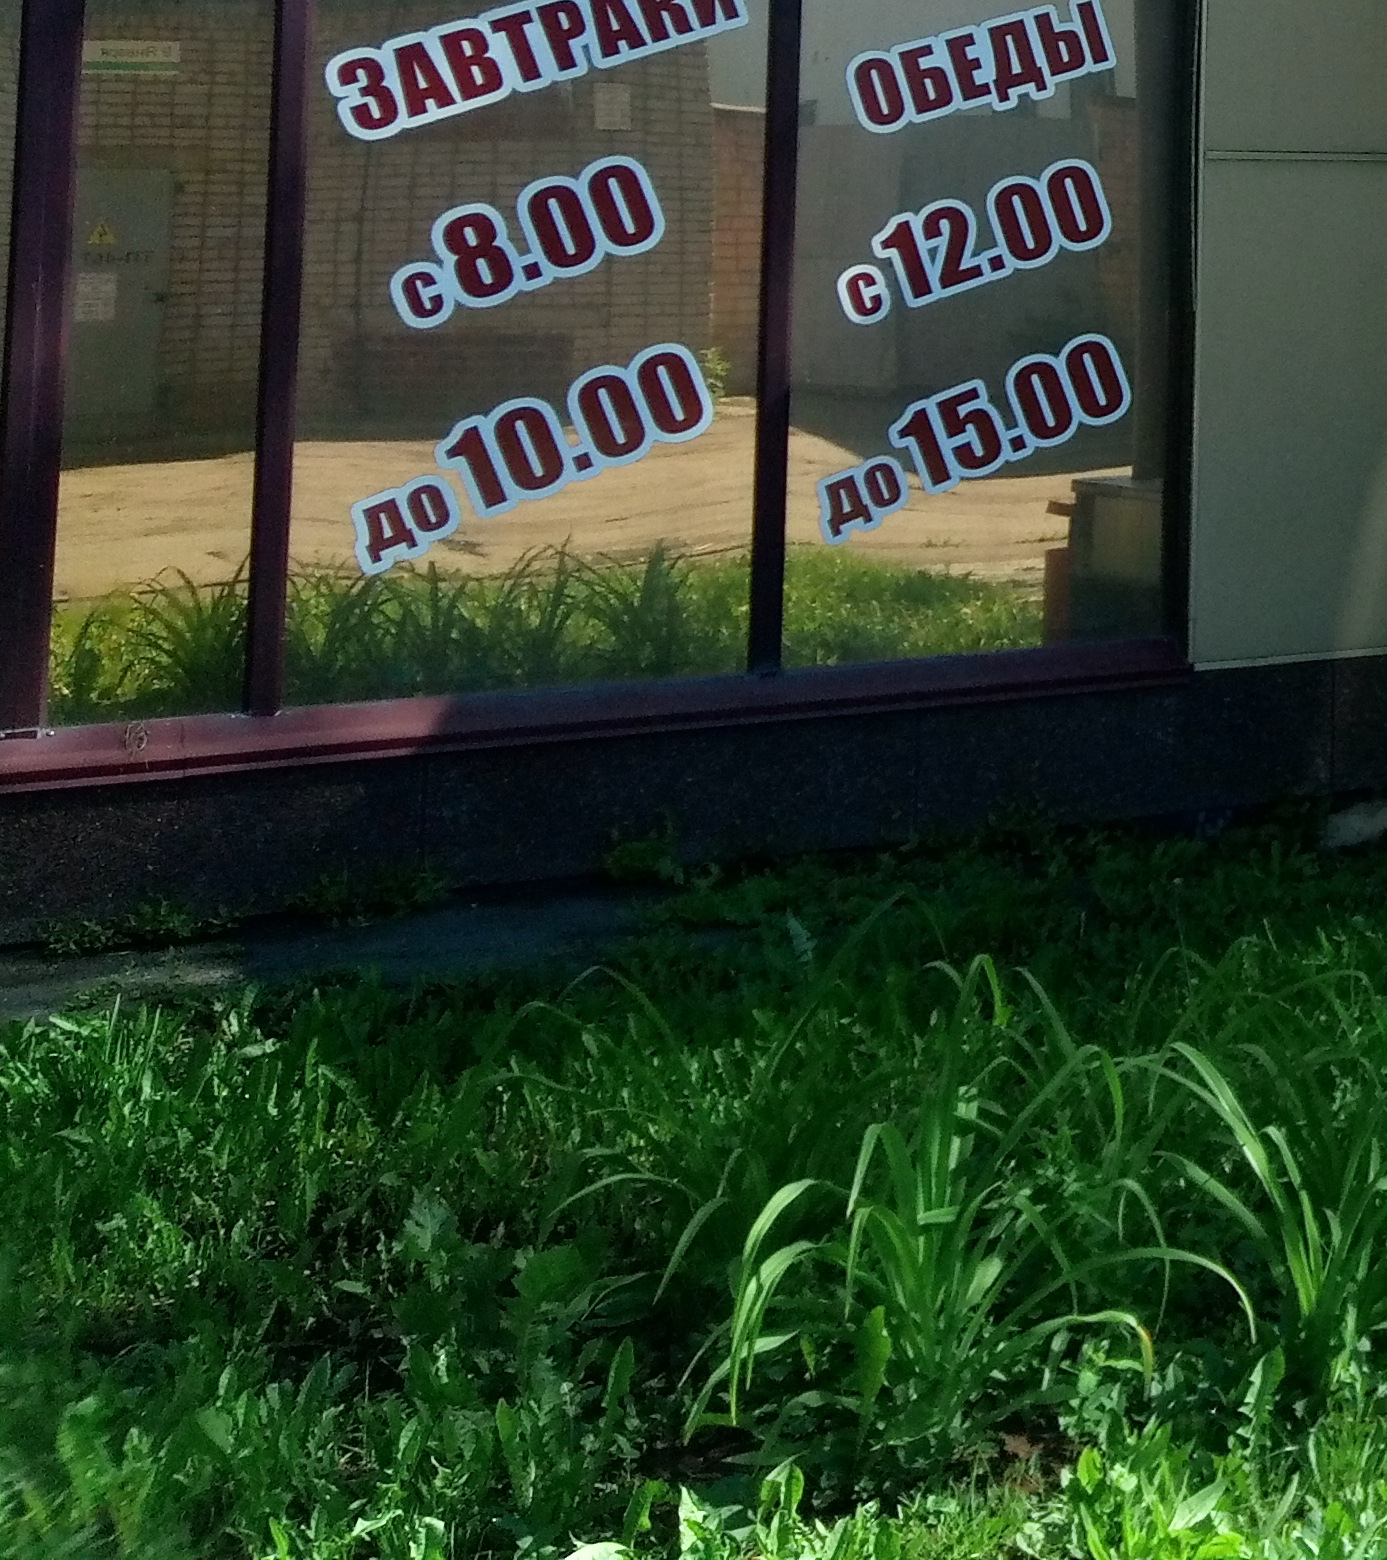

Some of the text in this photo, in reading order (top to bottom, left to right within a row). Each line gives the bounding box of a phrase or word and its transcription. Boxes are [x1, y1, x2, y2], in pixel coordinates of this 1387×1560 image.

[851, 1, 1112, 127] ОБЕДЫ
[400, 163, 659, 321] с 8.00
[844, 165, 1105, 318] с 12.00
[360, 349, 708, 565] до 10.00
[822, 338, 1125, 539] до 15.00
